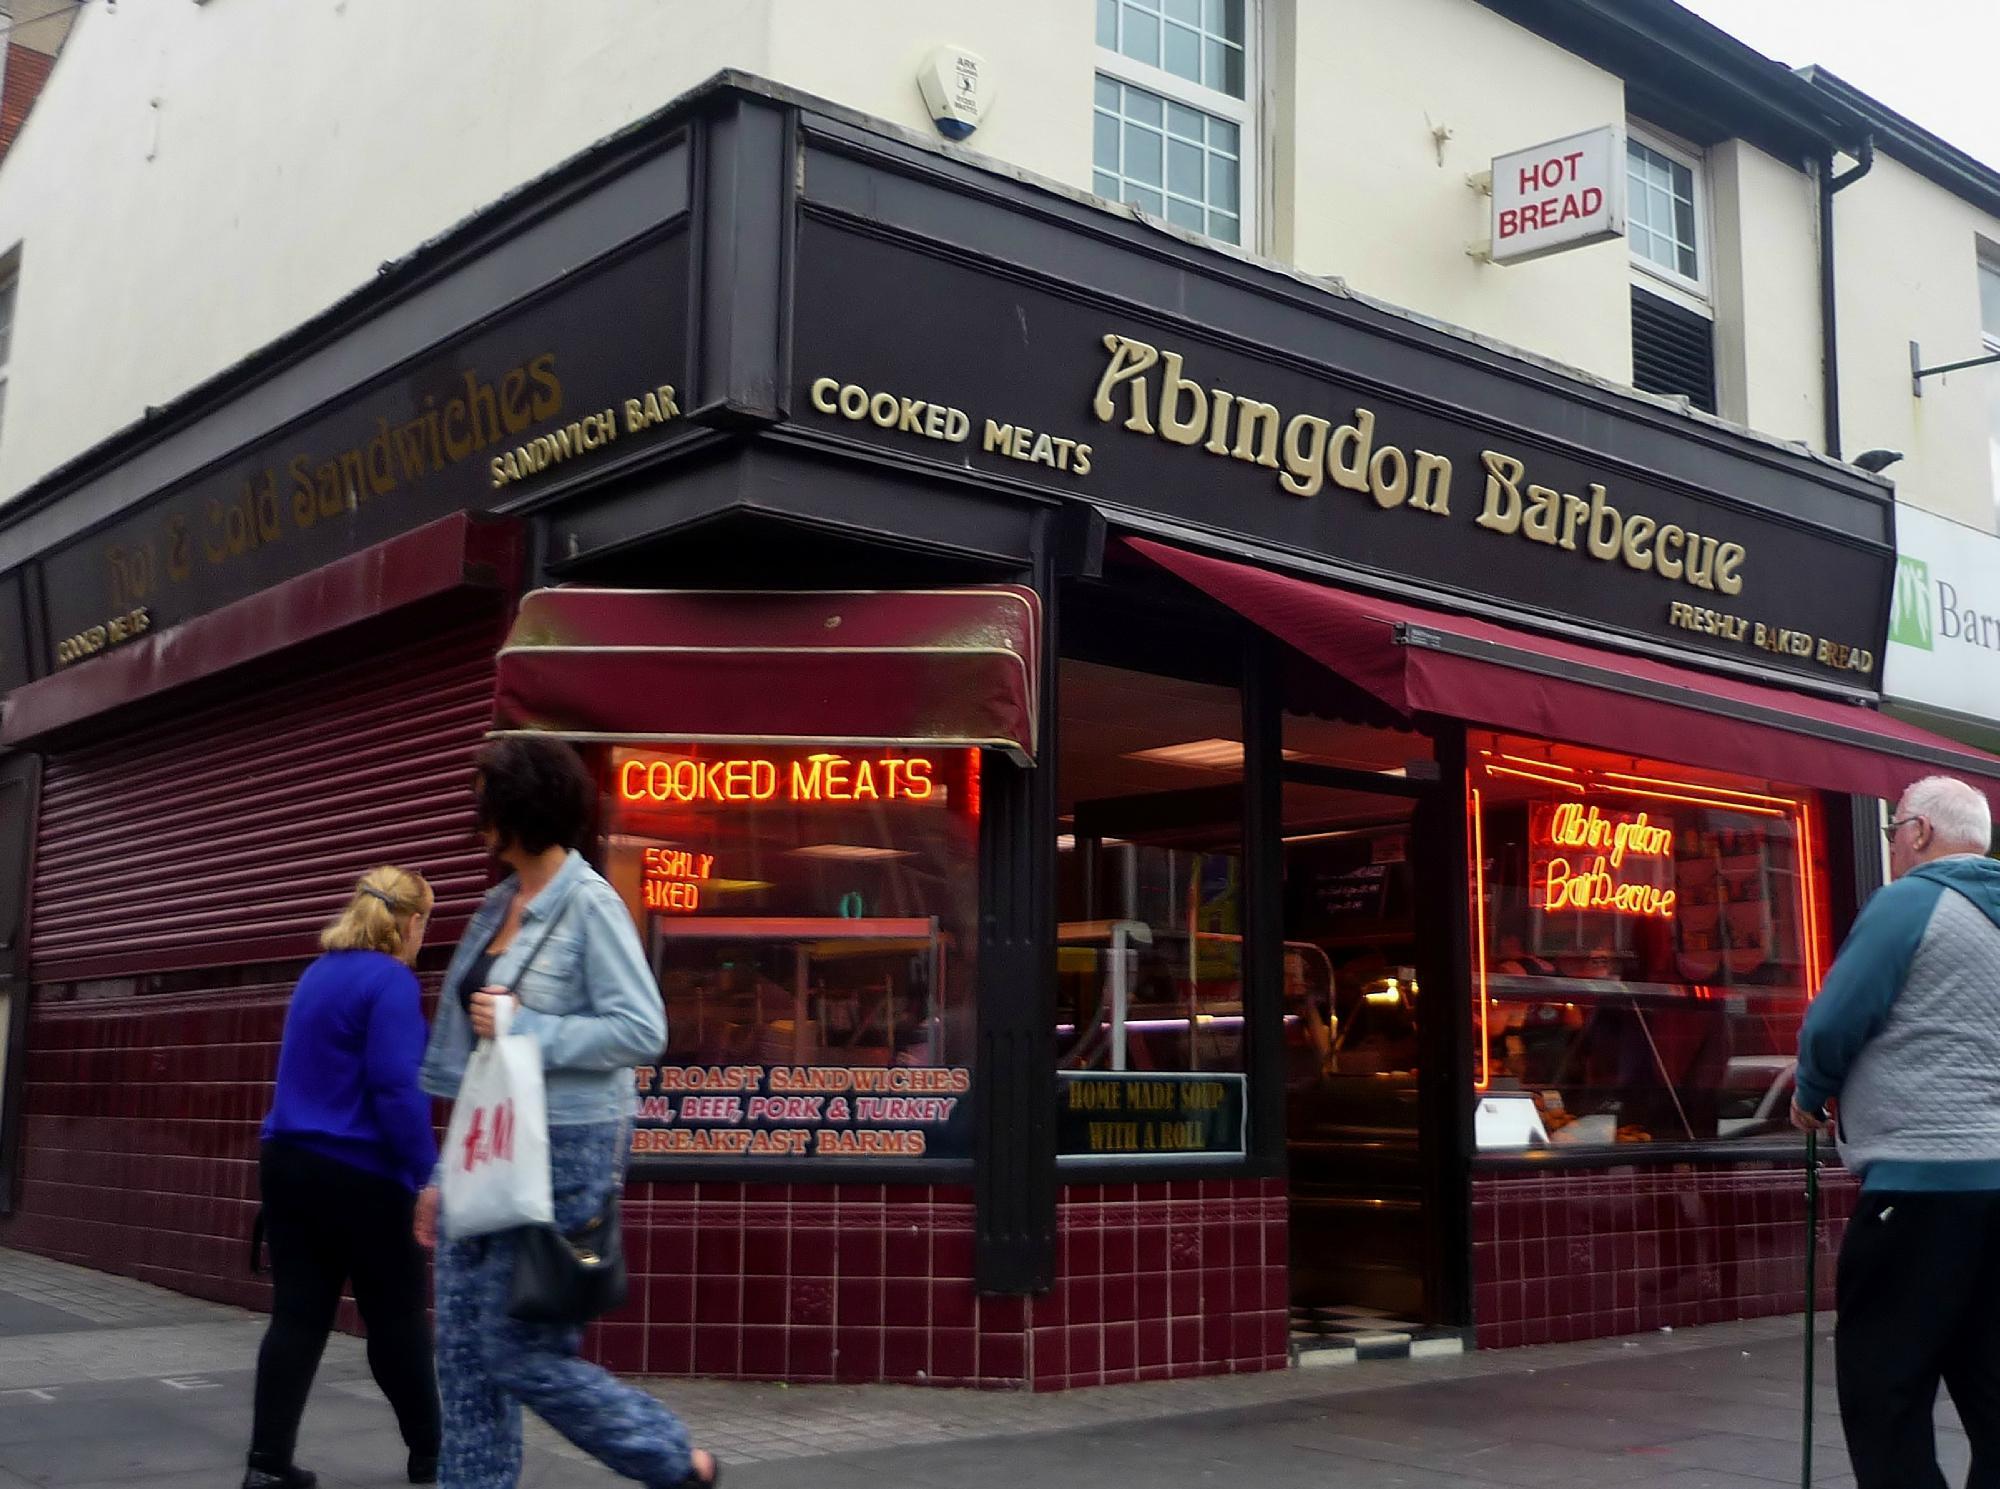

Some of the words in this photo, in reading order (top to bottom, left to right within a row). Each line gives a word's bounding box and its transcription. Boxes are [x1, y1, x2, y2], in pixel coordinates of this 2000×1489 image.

[1519, 151, 1584, 195] HOT
[1499, 187, 1603, 239] BREAD
[287, 353, 563, 529] Sandwiches
[490, 407, 618, 488] SANDWICH
[624, 384, 681, 433] BAR
[810, 377, 971, 443] COOKED
[983, 418, 1094, 476] MEATS
[1093, 333, 1451, 516] Abingdon
[1475, 450, 1747, 596] Barbecue
[1669, 601, 1750, 642] FRESHLY
[1753, 622, 1814, 657] BAKED
[1817, 637, 1874, 674] BREAD
[1935, 578, 2000, 652] Bar
[621, 759, 777, 802] COOKED
[791, 757, 934, 802] MEATS
[1551, 802, 1672, 868] Abingdon
[1544, 856, 1676, 917] Barbecue
[661, 1065, 765, 1092] ROAST
[769, 1066, 971, 1093] SANDWICHES
[1068, 1080, 1122, 1110] HOME
[1126, 1080, 1176, 1110] MADE
[748, 1096, 825, 1121] PORK
[826, 1096, 850, 1121] &
[856, 1096, 958, 1121] TURKEY
[1143, 1120, 1157, 1149] A
[1160, 1120, 1207, 1149] ROLL
[630, 1128, 812, 1155] BREAKFAST
[815, 1128, 927, 1155] BARMS
